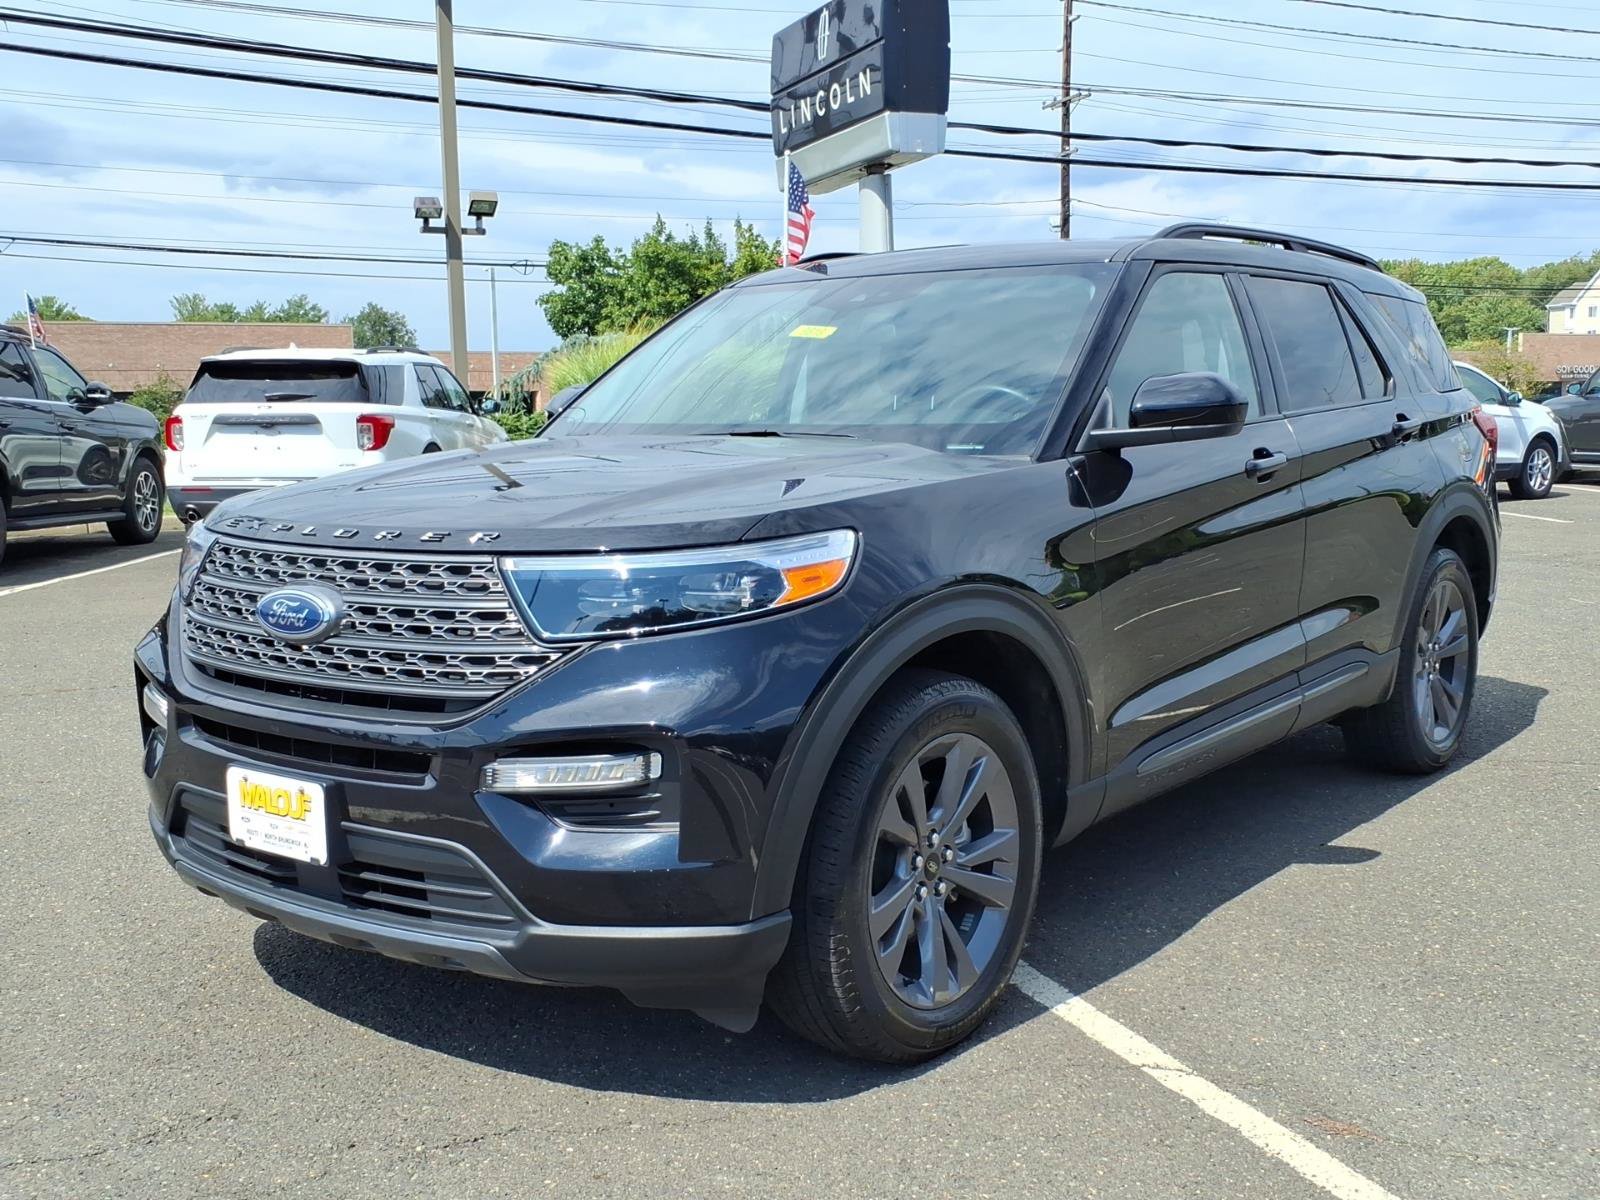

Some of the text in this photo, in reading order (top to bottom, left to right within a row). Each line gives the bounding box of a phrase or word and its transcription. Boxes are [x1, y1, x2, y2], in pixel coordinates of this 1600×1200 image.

[780, 68, 872, 134] LINCOLN
[1573, 365, 1595, 374] GOOD
[226, 518, 502, 543] EXPLORER
[268, 598, 309, 627] Ford
[239, 779, 312, 822] MALOUF
